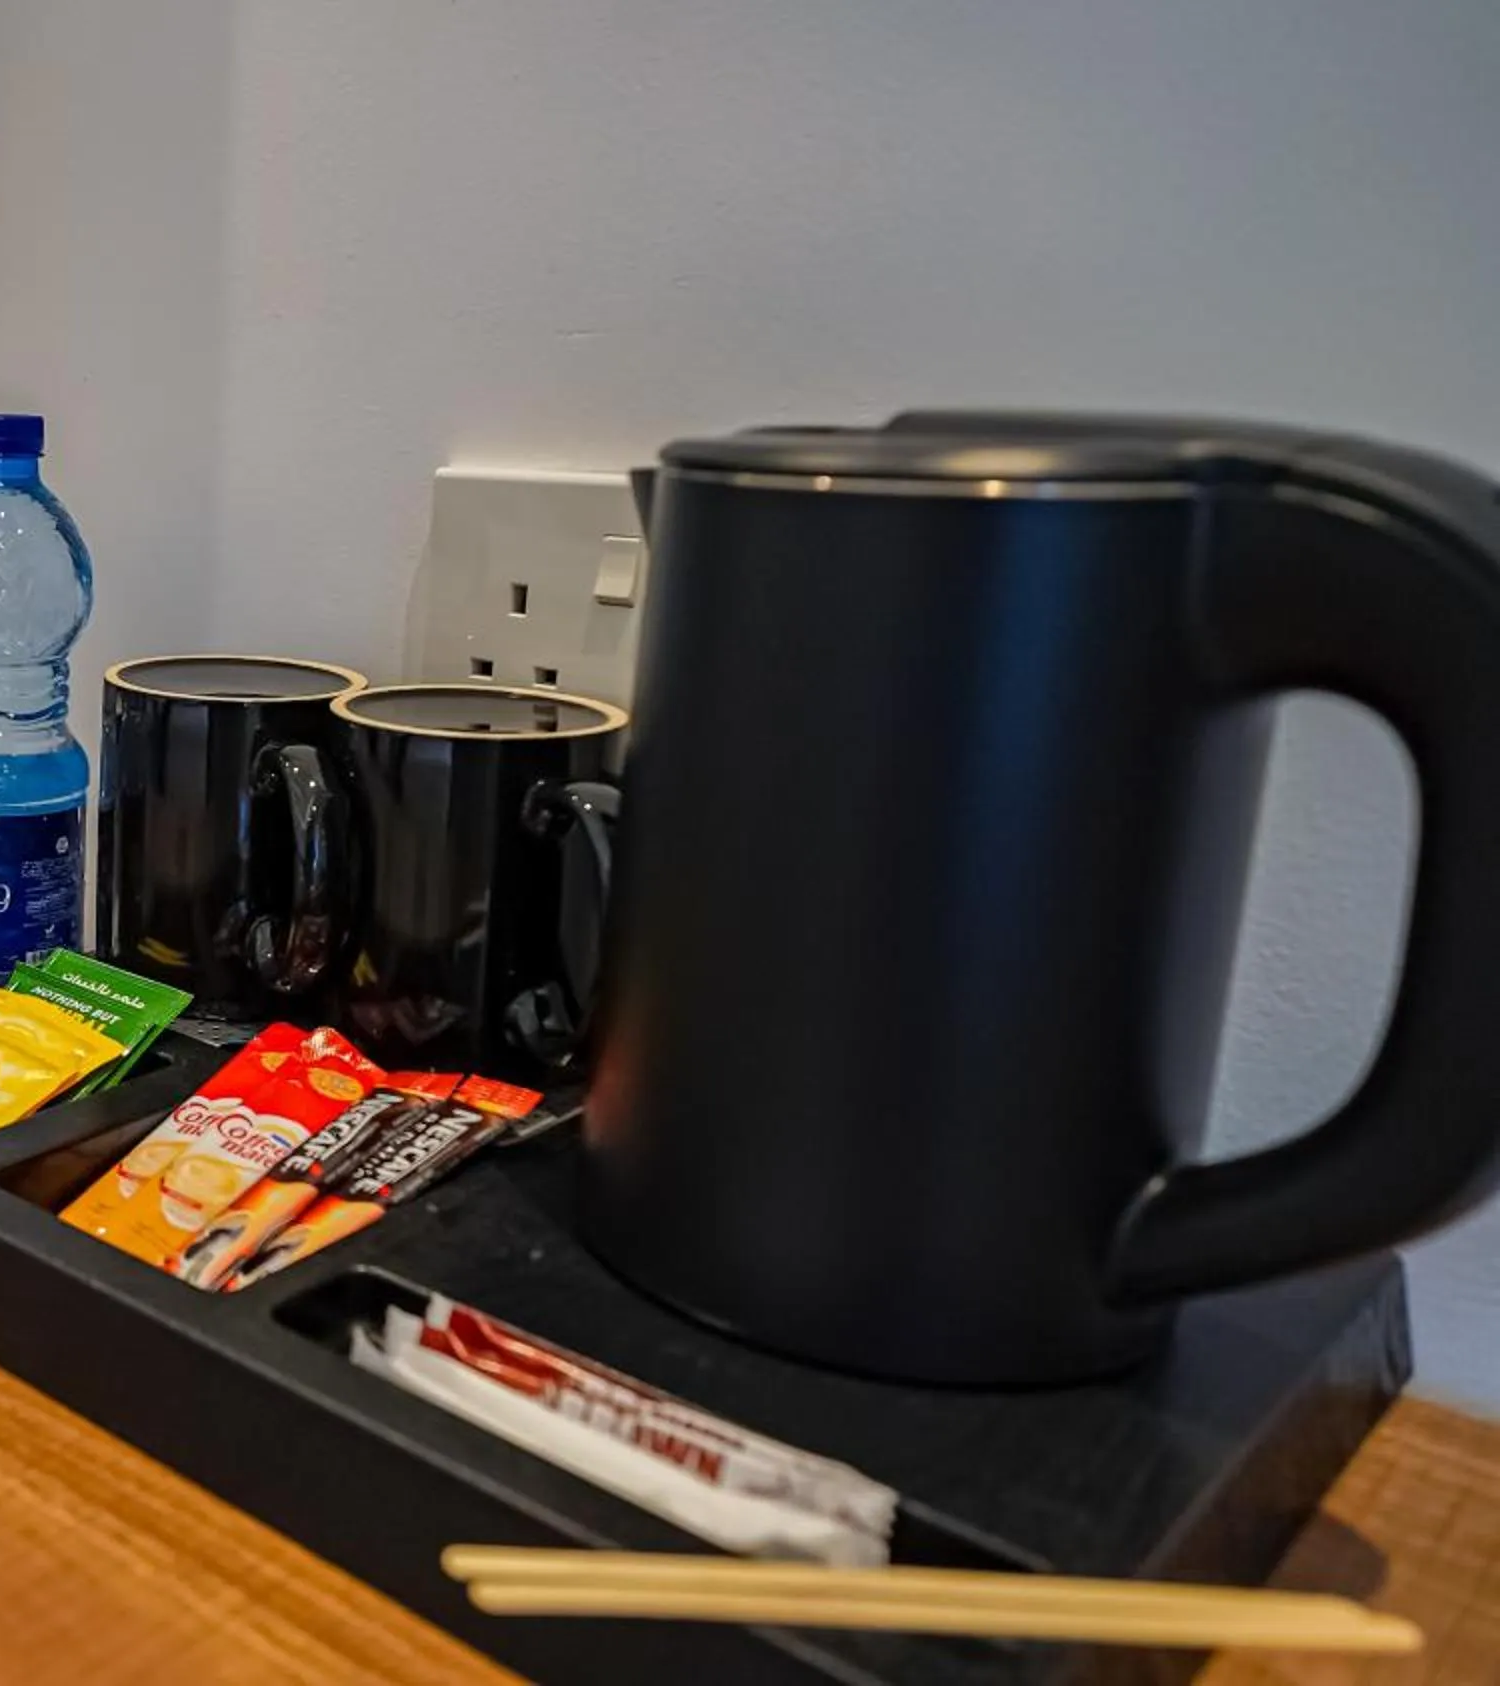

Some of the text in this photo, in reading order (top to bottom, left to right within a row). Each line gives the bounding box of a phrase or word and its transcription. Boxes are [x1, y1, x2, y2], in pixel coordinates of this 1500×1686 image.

[30, 986, 93, 1013] NOTHING
[173, 1102, 224, 1126] Coff
[217, 1113, 285, 1158] Coffee
